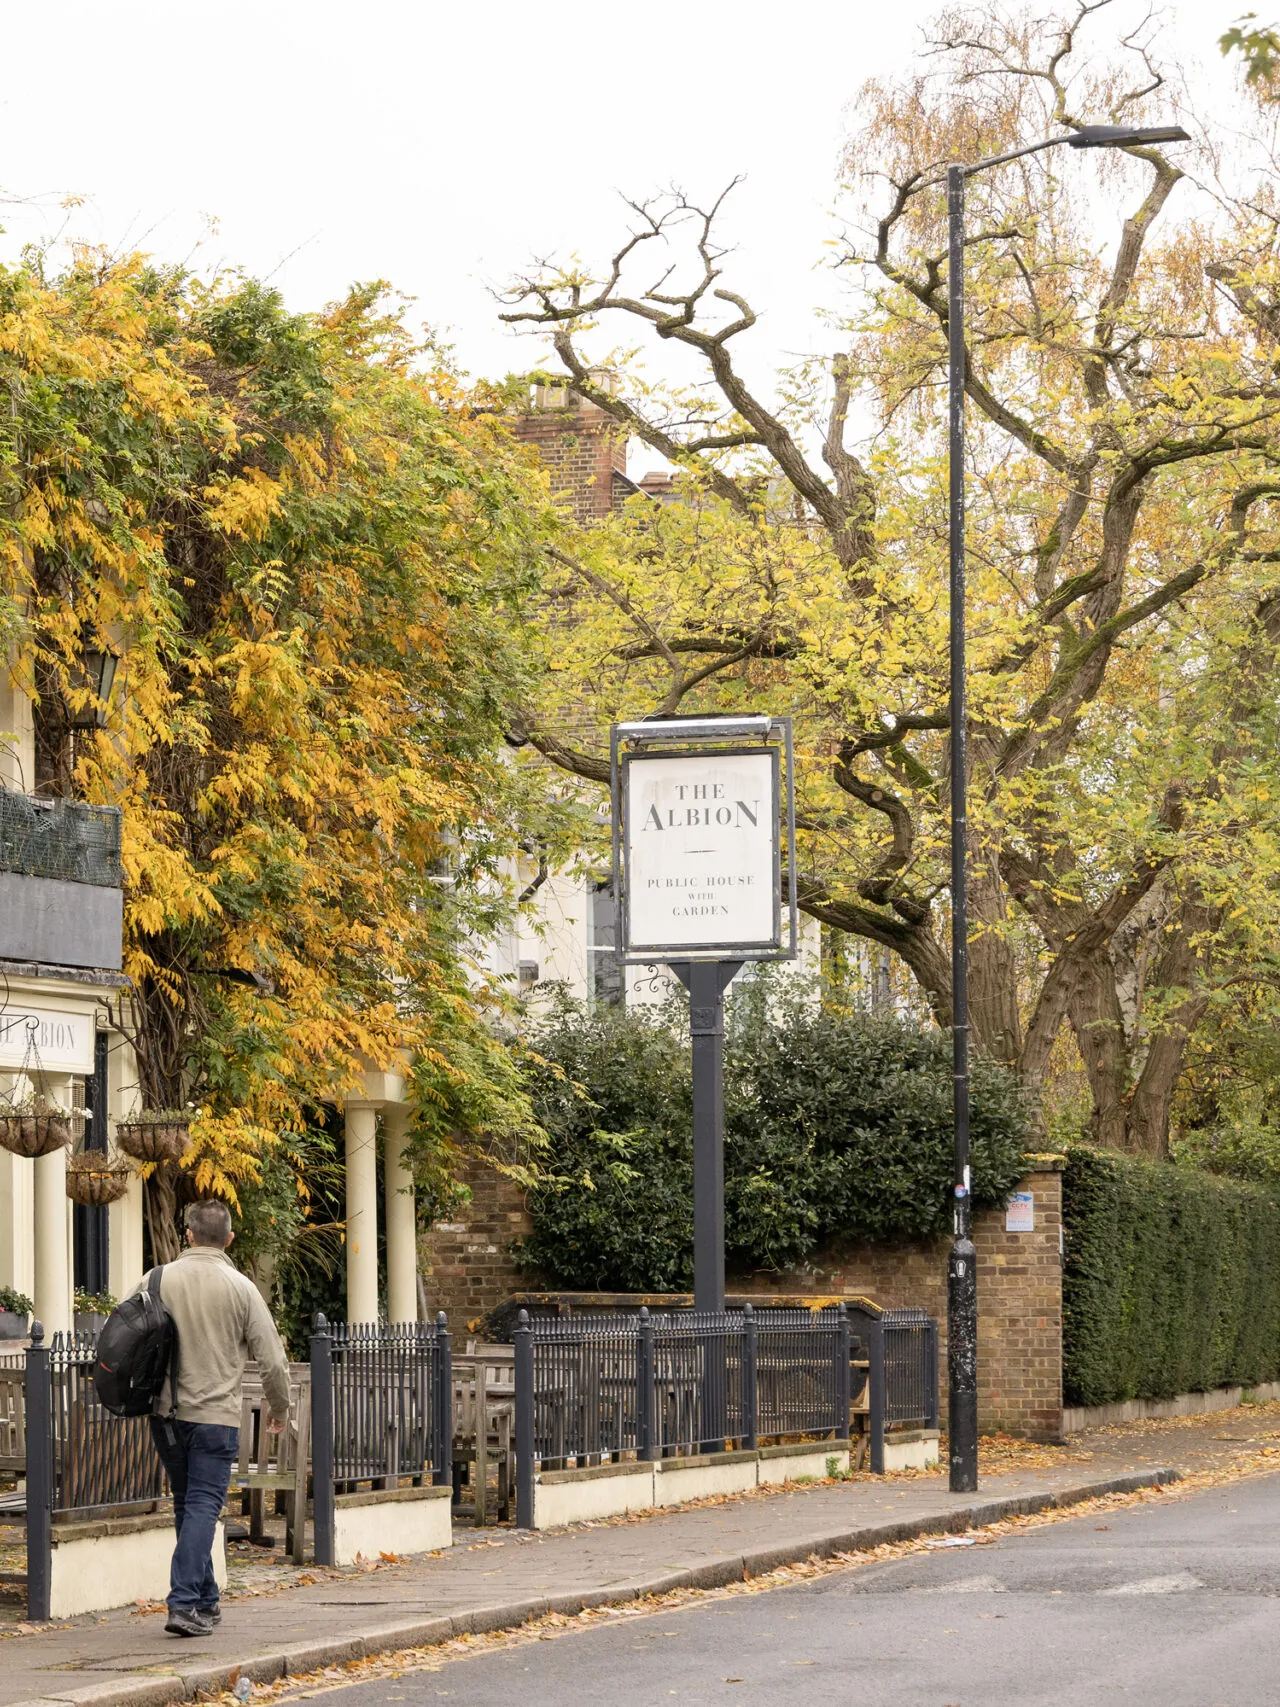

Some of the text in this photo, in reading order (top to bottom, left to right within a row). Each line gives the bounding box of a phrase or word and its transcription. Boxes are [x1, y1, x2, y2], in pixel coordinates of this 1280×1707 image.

[675, 783, 725, 800] THE
[641, 800, 760, 831] ALBION
[647, 875, 755, 889] PUBLIC HOUSE
[688, 892, 715, 901] WITH
[672, 905, 729, 917] GARDEN
